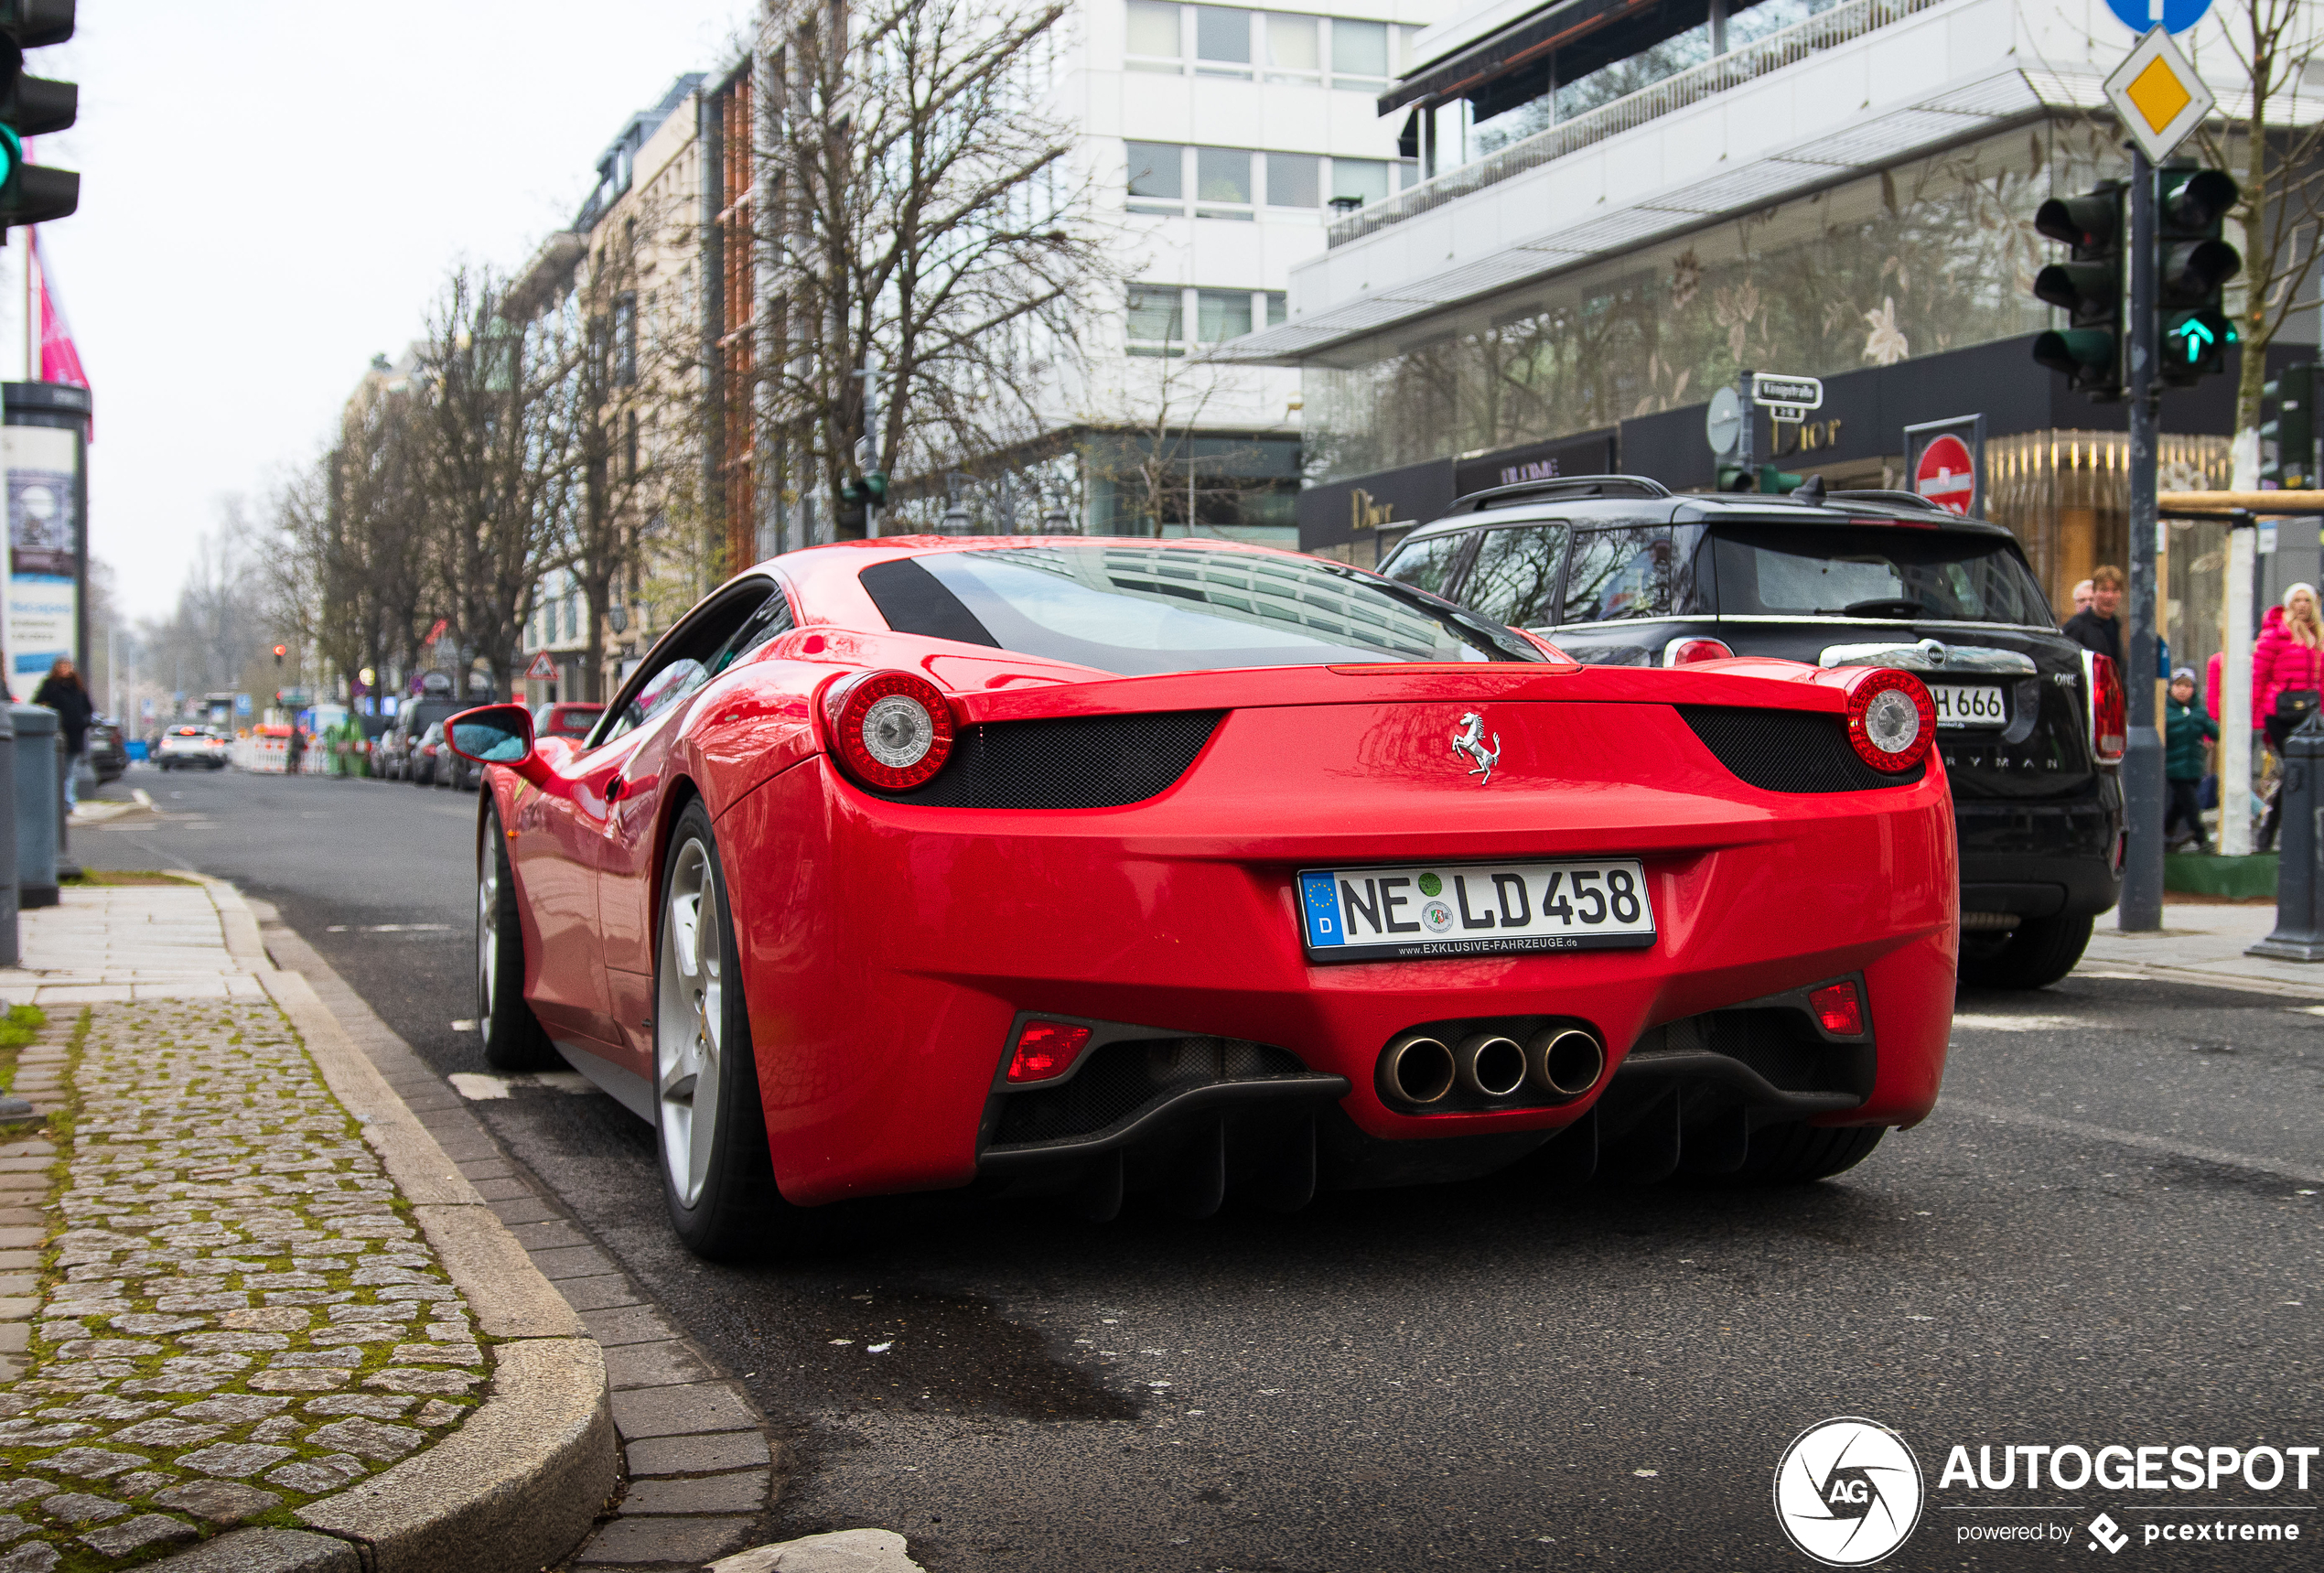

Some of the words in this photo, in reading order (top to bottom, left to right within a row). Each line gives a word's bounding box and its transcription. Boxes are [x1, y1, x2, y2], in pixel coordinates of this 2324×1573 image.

[1770, 418, 1842, 458] Dior
[1351, 488, 1394, 530] Dior
[2054, 673, 2078, 686] ONE
[1957, 689, 2002, 716] 666
[1945, 756, 2059, 770] RYMAN
[1340, 877, 1421, 935] NE
[1454, 872, 1532, 930] LD
[1543, 869, 1641, 925] 458
[1318, 917, 1333, 933] D
[1398, 937, 1577, 955] www.EXKLUSIVE-FAHRZEUGE.de
